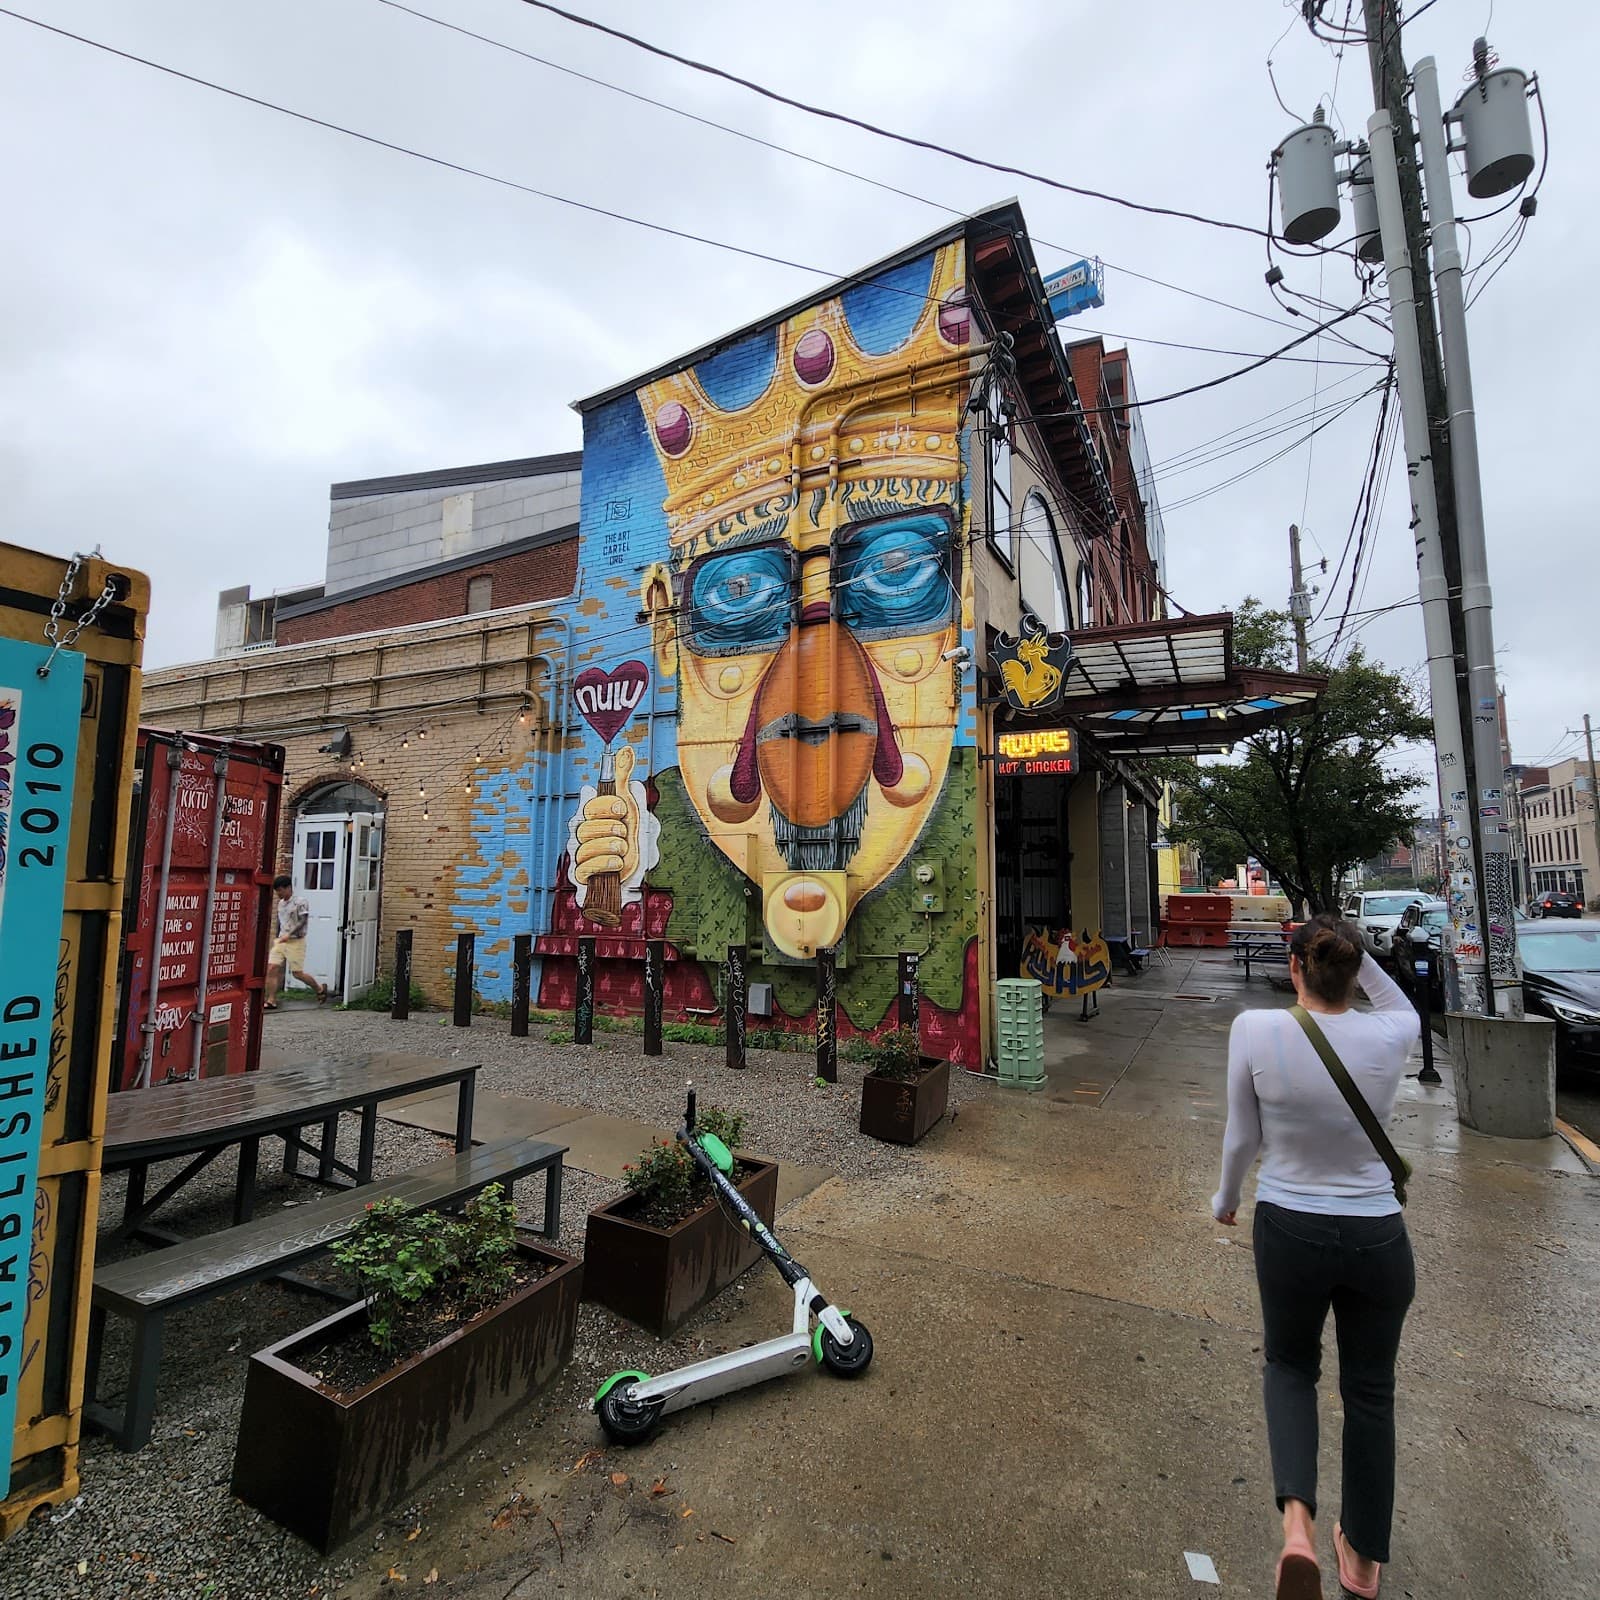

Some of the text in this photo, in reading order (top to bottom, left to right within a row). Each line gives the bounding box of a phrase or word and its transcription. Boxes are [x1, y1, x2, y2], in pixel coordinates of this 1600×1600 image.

[605, 530, 630, 544] THE ART
[602, 542, 630, 556] CARTEL
[999, 762, 1019, 774] HOT
[19, 743, 64, 868] 2010
[181, 789, 209, 810] KKTU
[165, 918, 183, 933] TARE
[0, 994, 41, 1396] BLISHED
